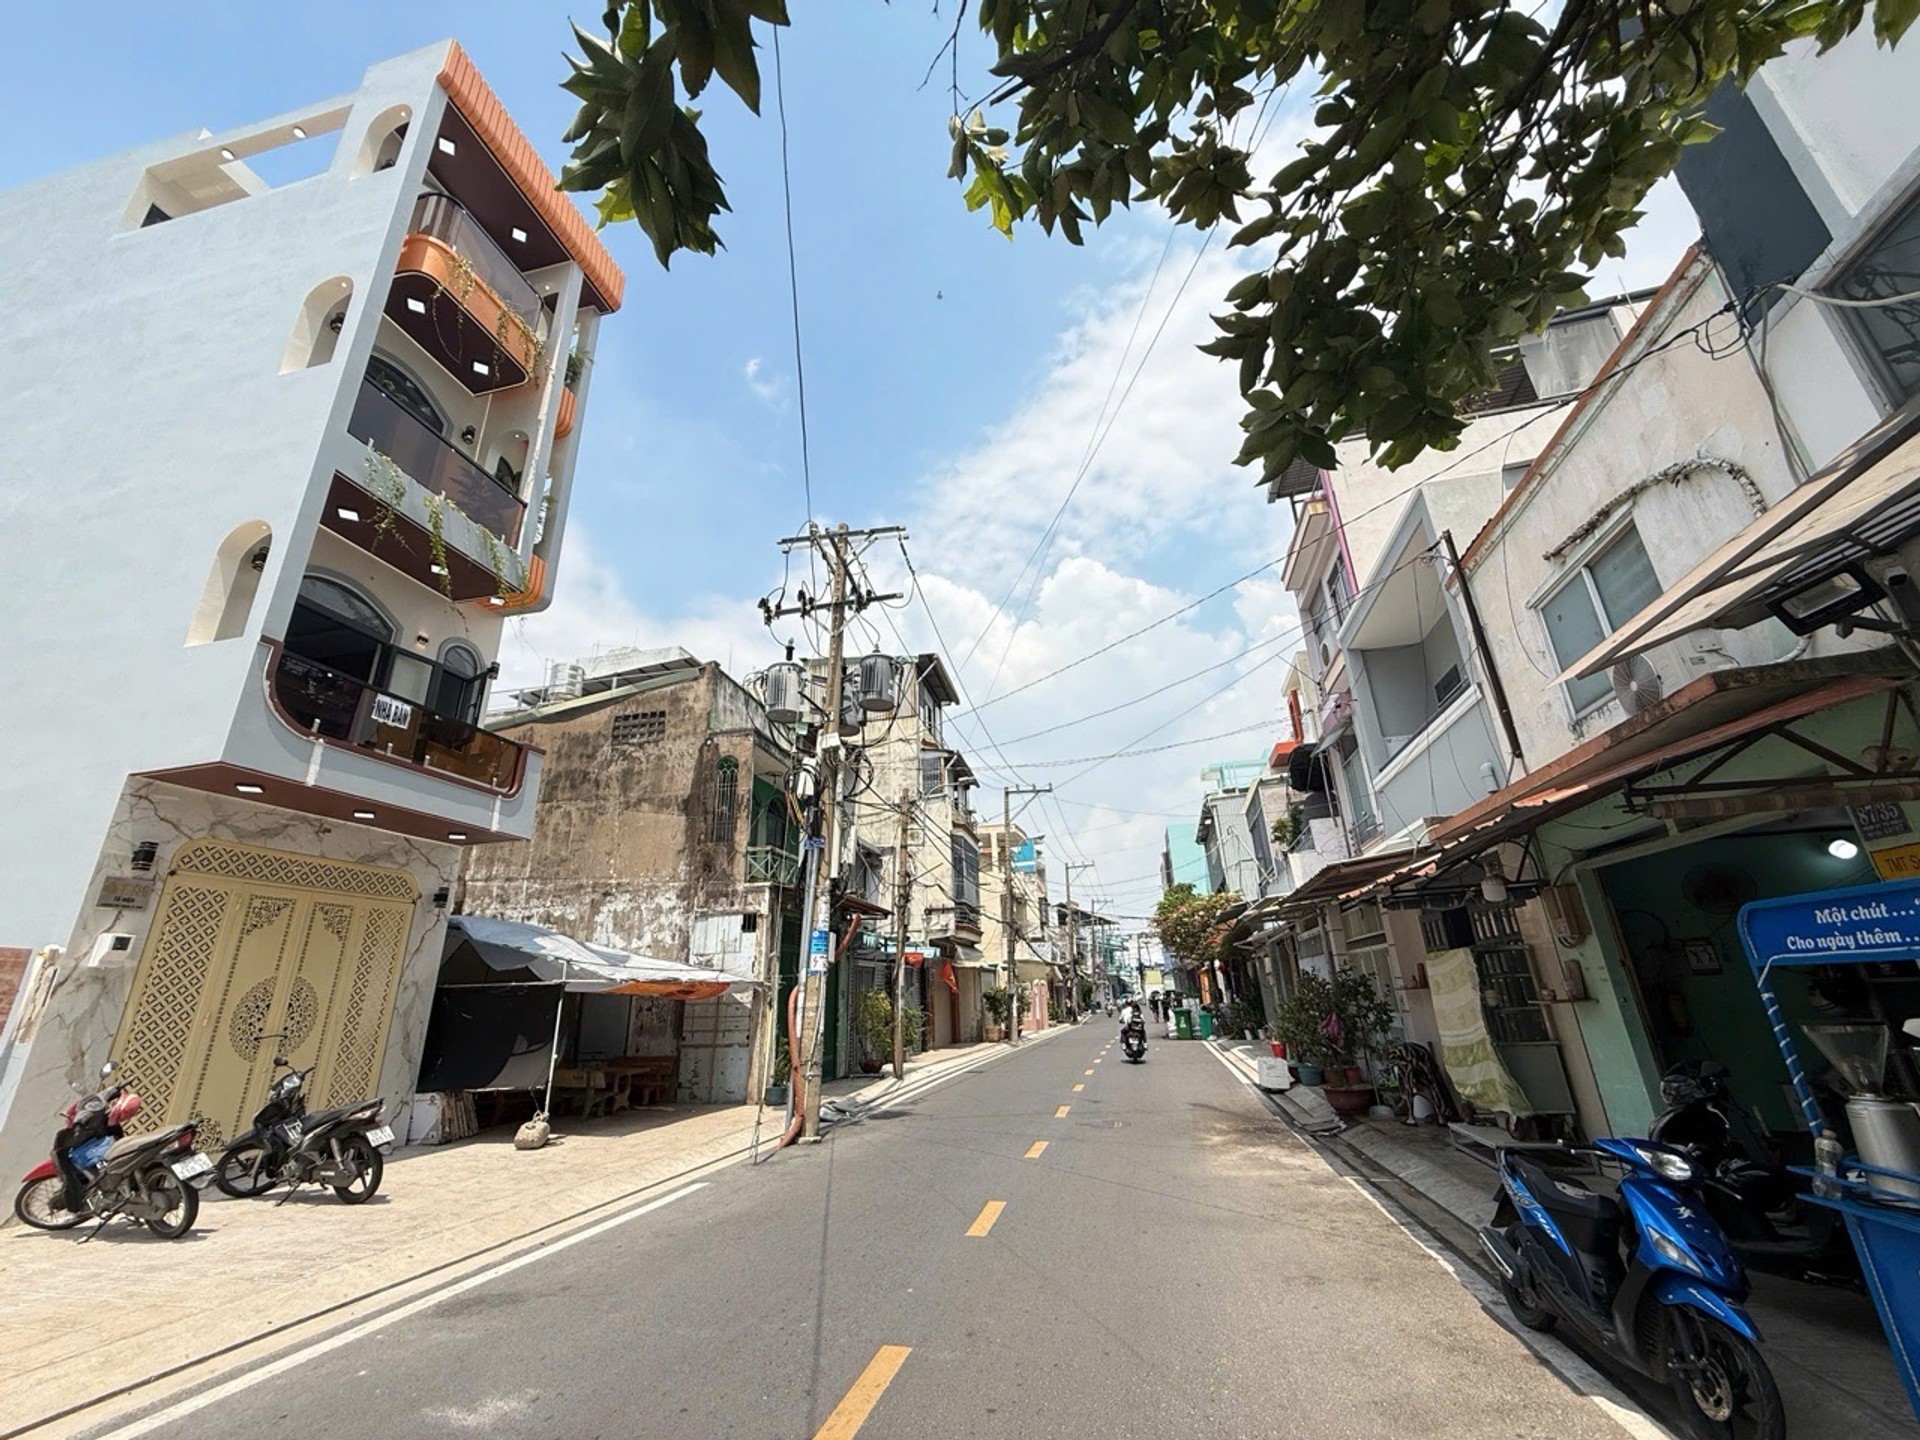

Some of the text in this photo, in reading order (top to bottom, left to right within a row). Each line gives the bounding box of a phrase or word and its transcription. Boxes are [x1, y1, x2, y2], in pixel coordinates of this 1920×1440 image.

[1856, 801, 1899, 825] 87/35
[1885, 857, 1908, 872] TMT
[1814, 906, 1849, 927] Một
[1786, 935, 1815, 950] Cho
[1816, 931, 1856, 951] ngày
